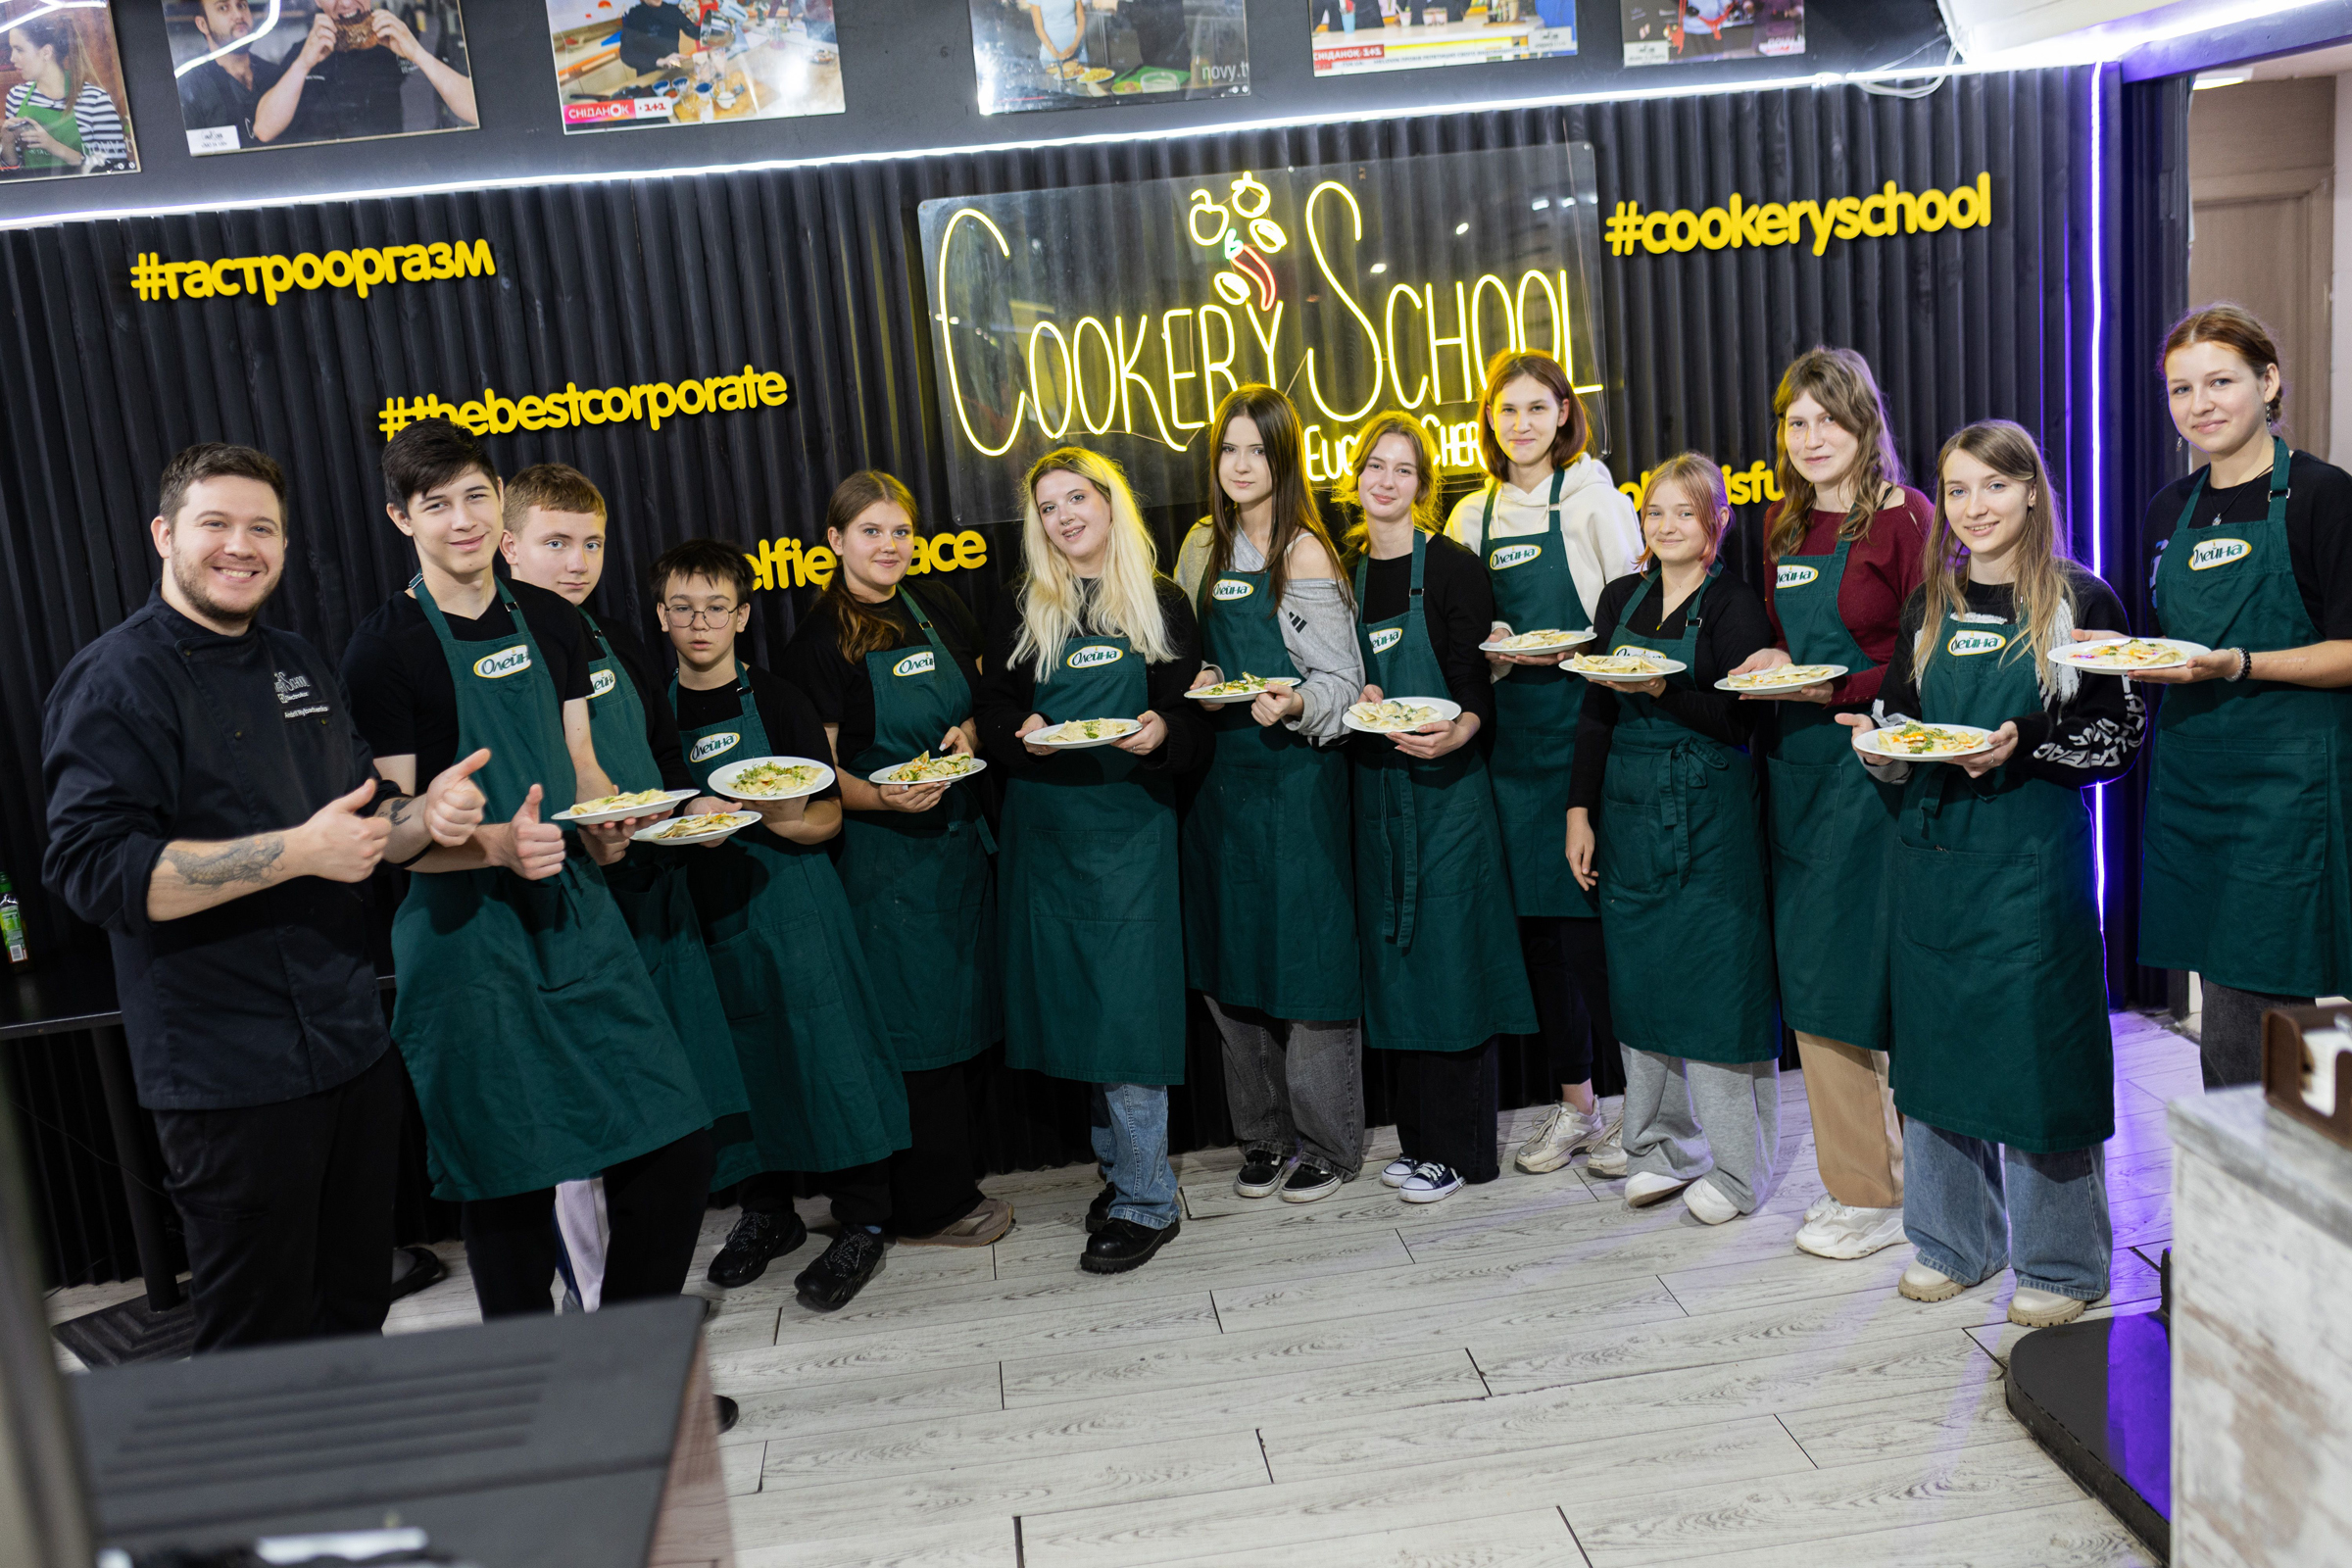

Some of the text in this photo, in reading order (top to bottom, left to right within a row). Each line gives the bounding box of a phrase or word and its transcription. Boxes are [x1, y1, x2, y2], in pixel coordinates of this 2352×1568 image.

[568, 102, 666, 119] СНІДАНОК 1+1
[1604, 171, 1991, 257] #cookeryschool
[130, 238, 496, 306] #гастрооргазм
[938, 180, 1604, 457] COOKERY SCHOOL
[378, 365, 788, 442] #thebestcorporate
[1492, 548, 1536, 567] Олейна
[1373, 631, 1399, 648] ейна
[1071, 650, 1117, 666] Олейна
[692, 735, 734, 760] Олейна
